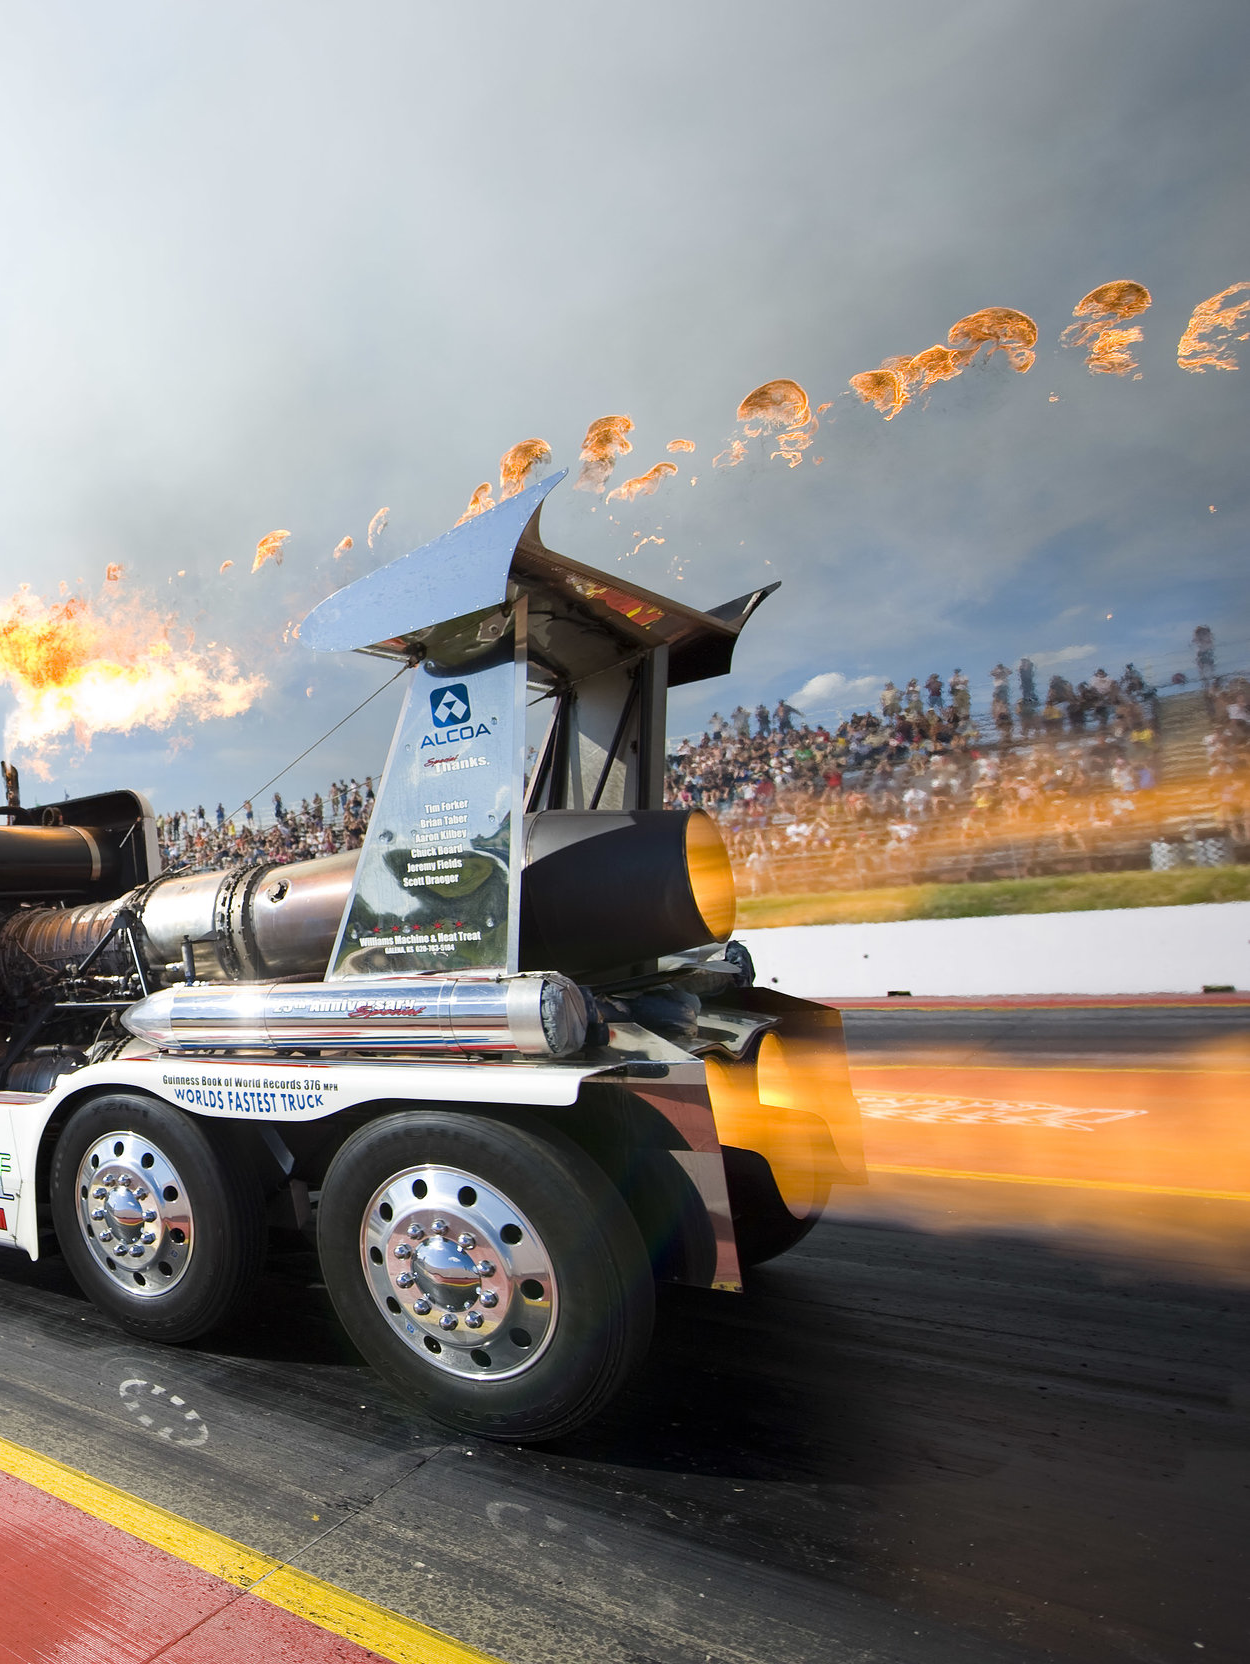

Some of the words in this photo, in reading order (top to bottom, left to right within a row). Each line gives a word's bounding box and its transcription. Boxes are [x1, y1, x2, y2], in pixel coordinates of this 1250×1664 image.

[420, 723, 491, 749] ALCOA
[434, 757, 490, 773] Thanks.
[424, 804, 440, 814] Tim
[420, 818, 443, 829] Brian
[443, 815, 468, 826] Taber
[415, 833, 439, 844] Aaron
[410, 847, 437, 859] Chuck
[407, 862, 437, 873] Jeremy
[437, 858, 463, 870] Fields
[402, 876, 425, 887] Scott
[425, 873, 460, 885] Draeger
[359, 936, 394, 947] Williams
[394, 934, 430, 945] Machine
[430, 934, 438, 943] &
[438, 932, 458, 943] Heat
[458, 931, 481, 942] Treat
[272, 1000, 307, 1014] 25th
[309, 999, 417, 1013] Anniversary
[162, 1074, 200, 1086] Guinness
[201, 1075, 222, 1087] Book
[224, 1077, 233, 1087] of
[234, 1077, 261, 1089] World
[263, 1078, 301, 1090] Records
[303, 1079, 321, 1091] 376
[323, 1083, 339, 1092] MPH
[174, 1088, 225, 1110] WORLDS
[227, 1091, 277, 1113] FASTEST
[280, 1093, 325, 1112] TRUCK
